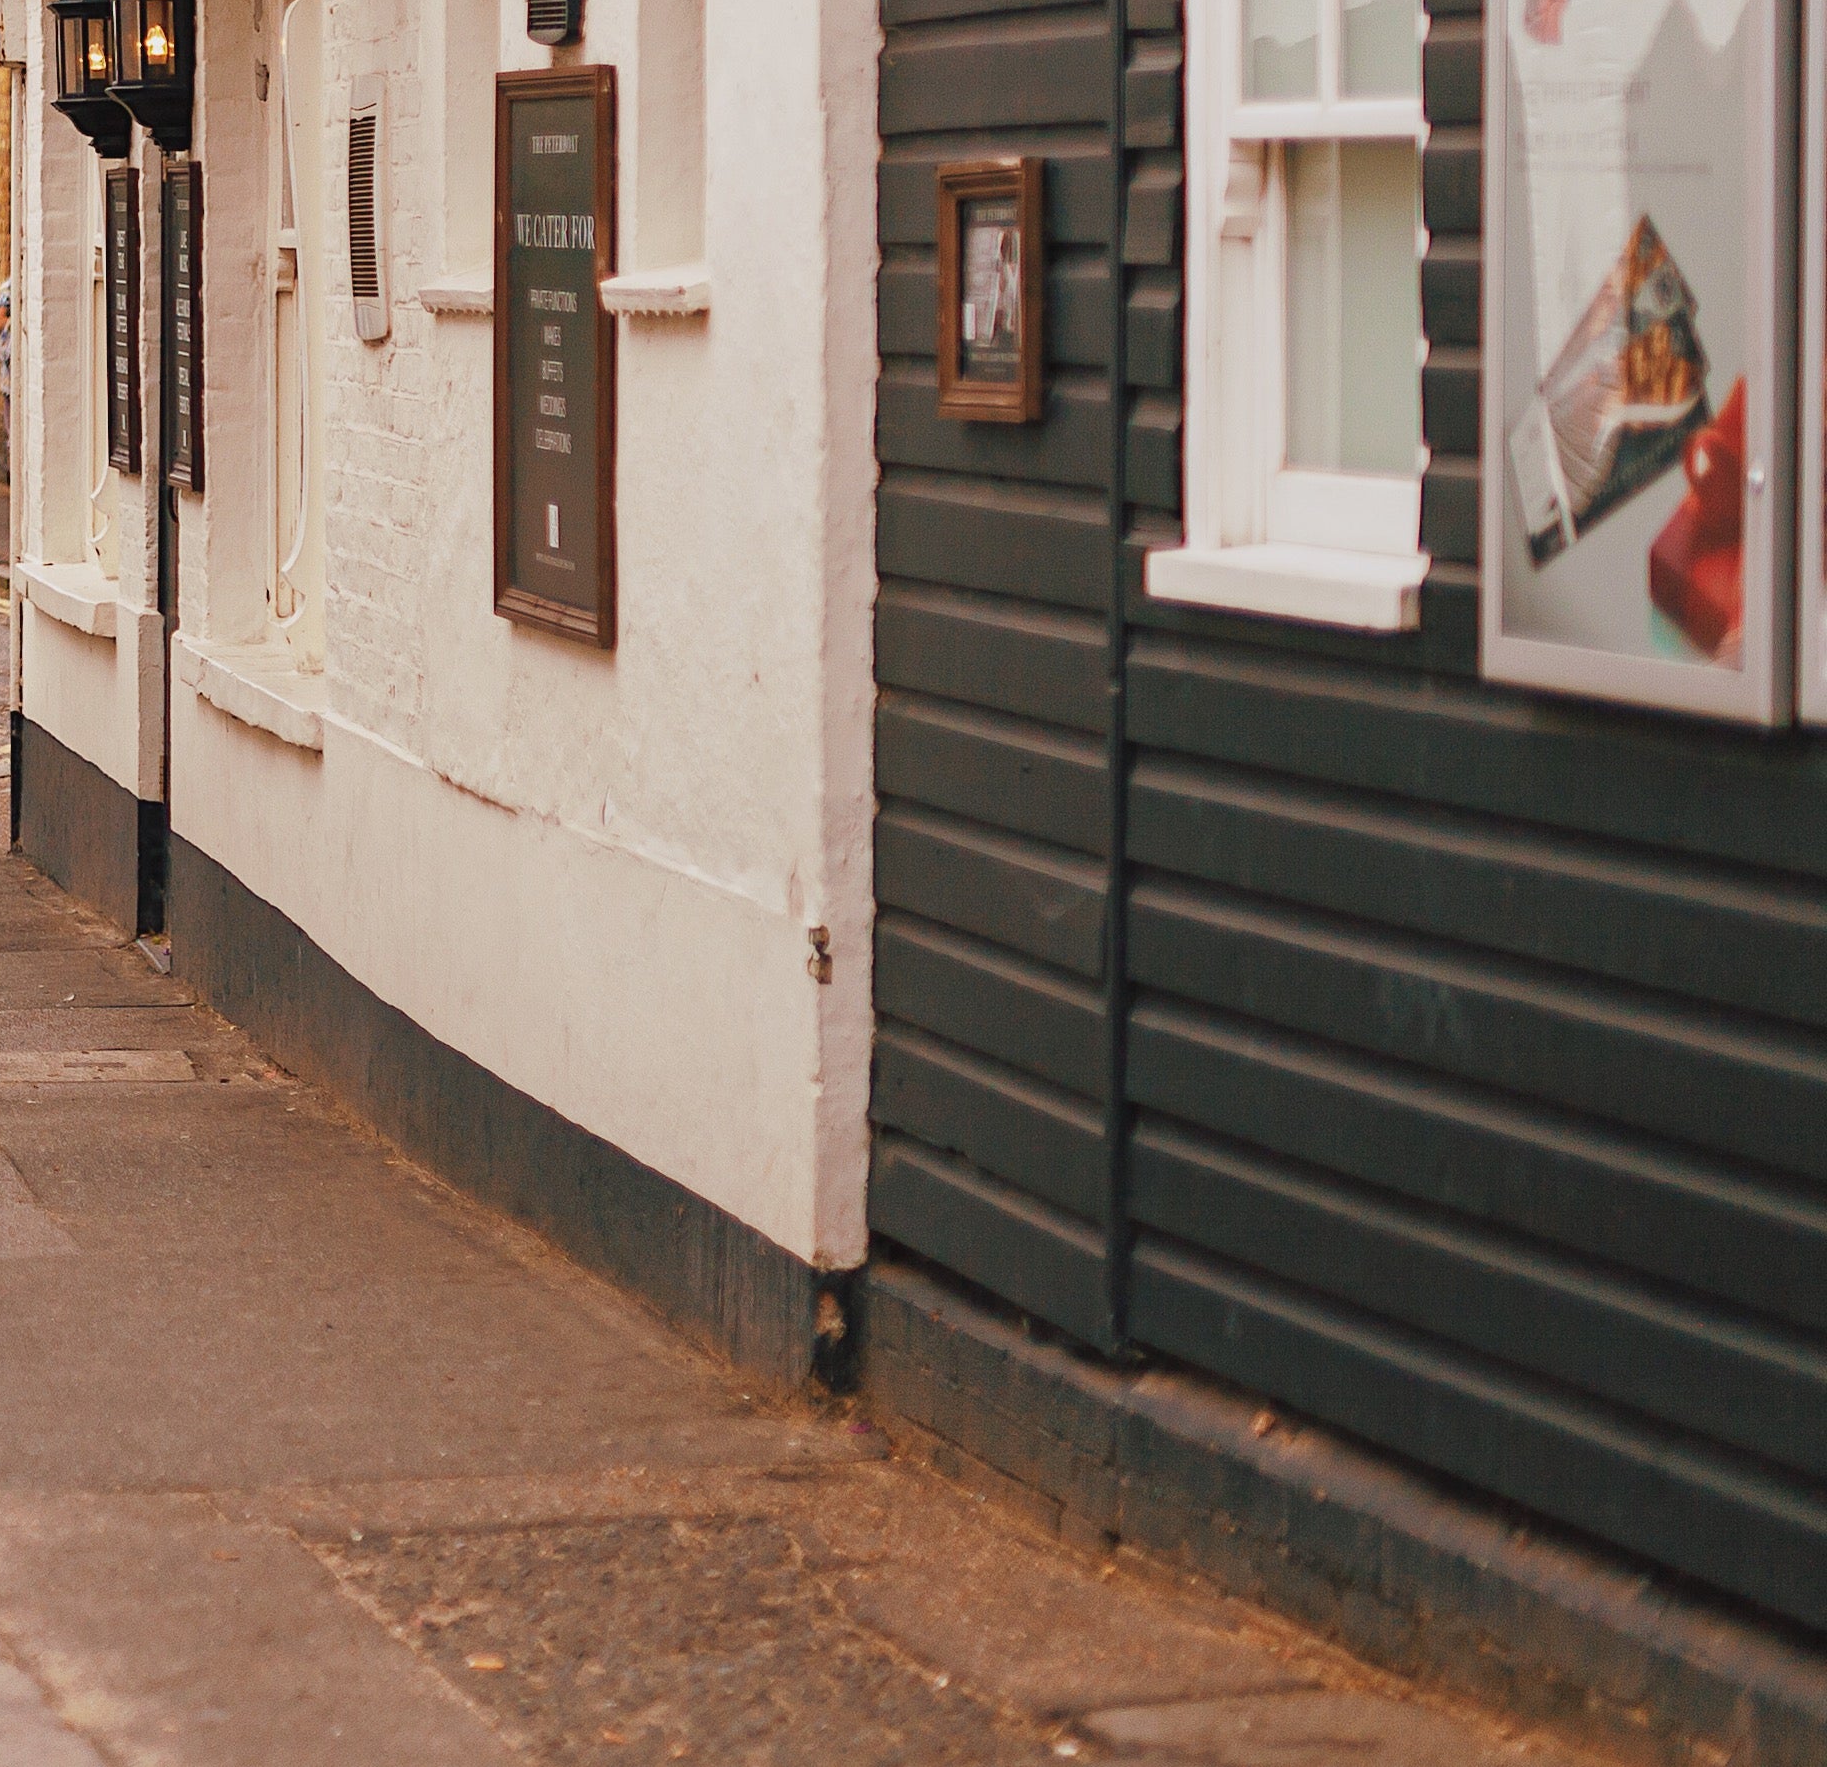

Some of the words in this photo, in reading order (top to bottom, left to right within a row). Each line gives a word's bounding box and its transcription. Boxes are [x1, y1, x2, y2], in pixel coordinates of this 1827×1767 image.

[517, 214, 532, 247] WE
[533, 214, 569, 249] CATER
[571, 215, 595, 250] FOR
